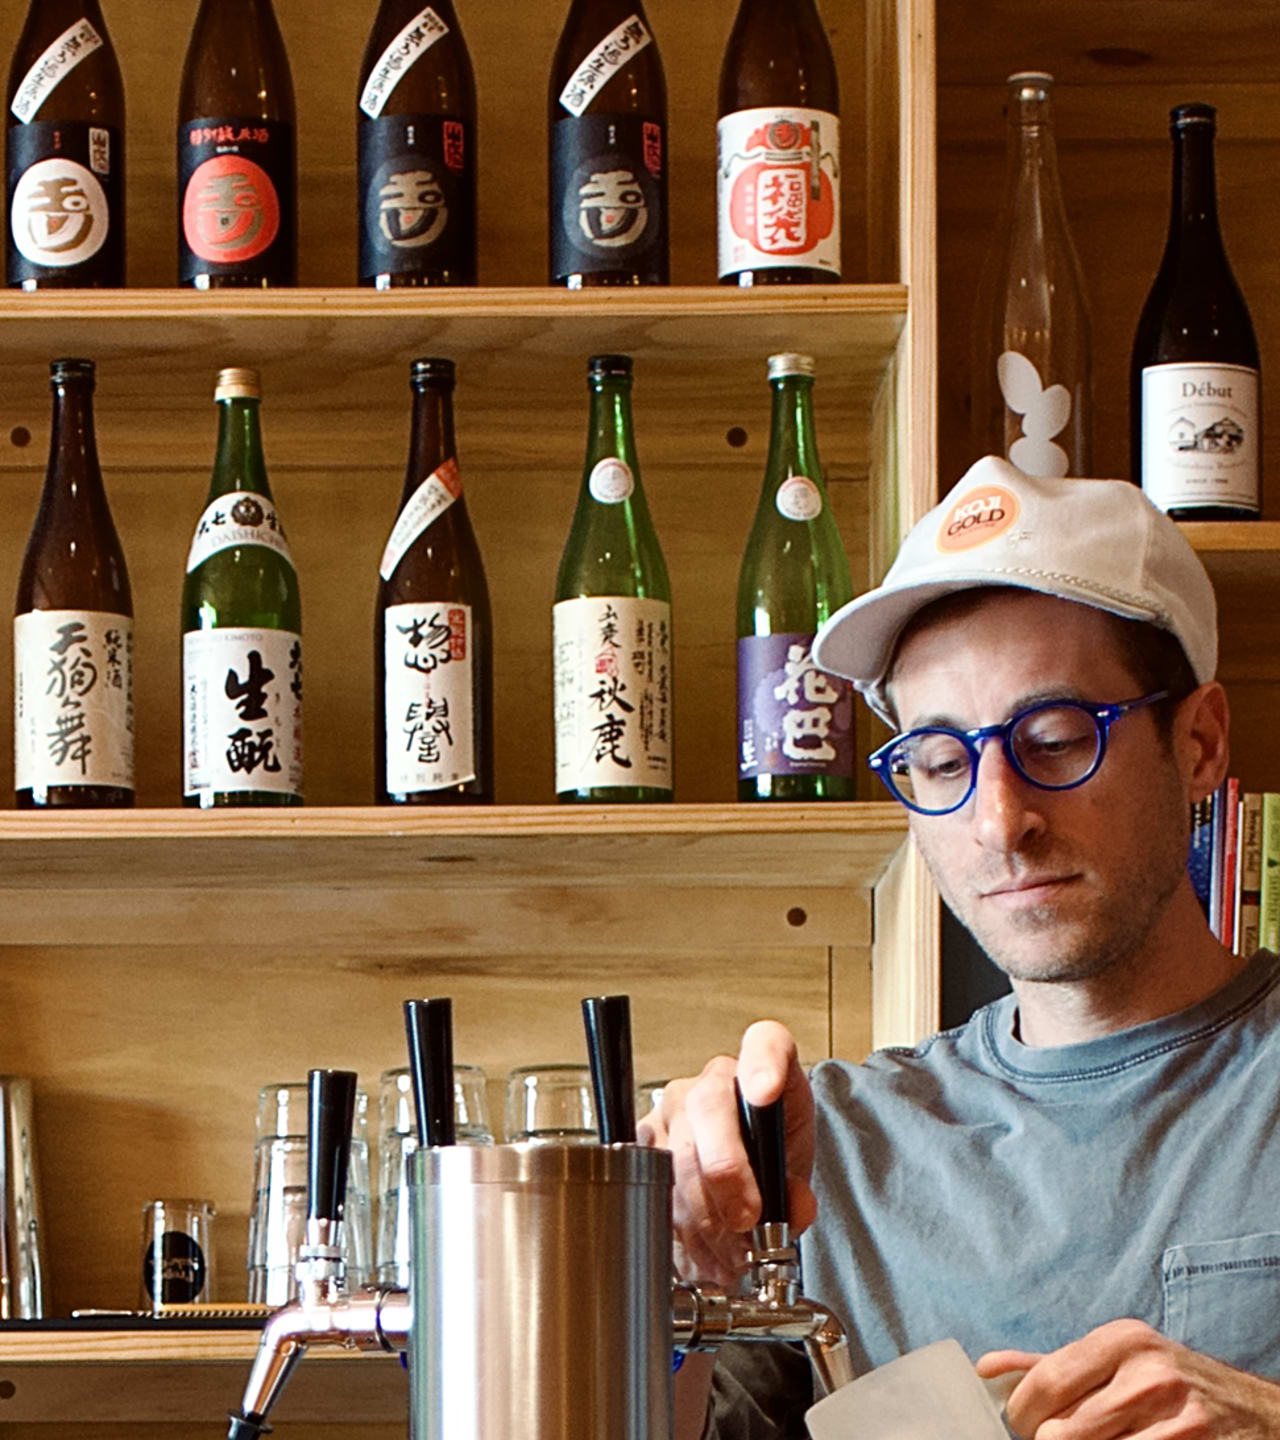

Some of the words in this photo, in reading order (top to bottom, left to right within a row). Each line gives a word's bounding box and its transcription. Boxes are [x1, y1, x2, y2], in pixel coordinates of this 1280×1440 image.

[1182, 382, 1233, 398] Début
[948, 508, 1005, 536] GOLD
[954, 496, 1001, 521] KOJI
[45, 621, 97, 776] 天狗舞
[588, 676, 635, 769] 秋鹿
